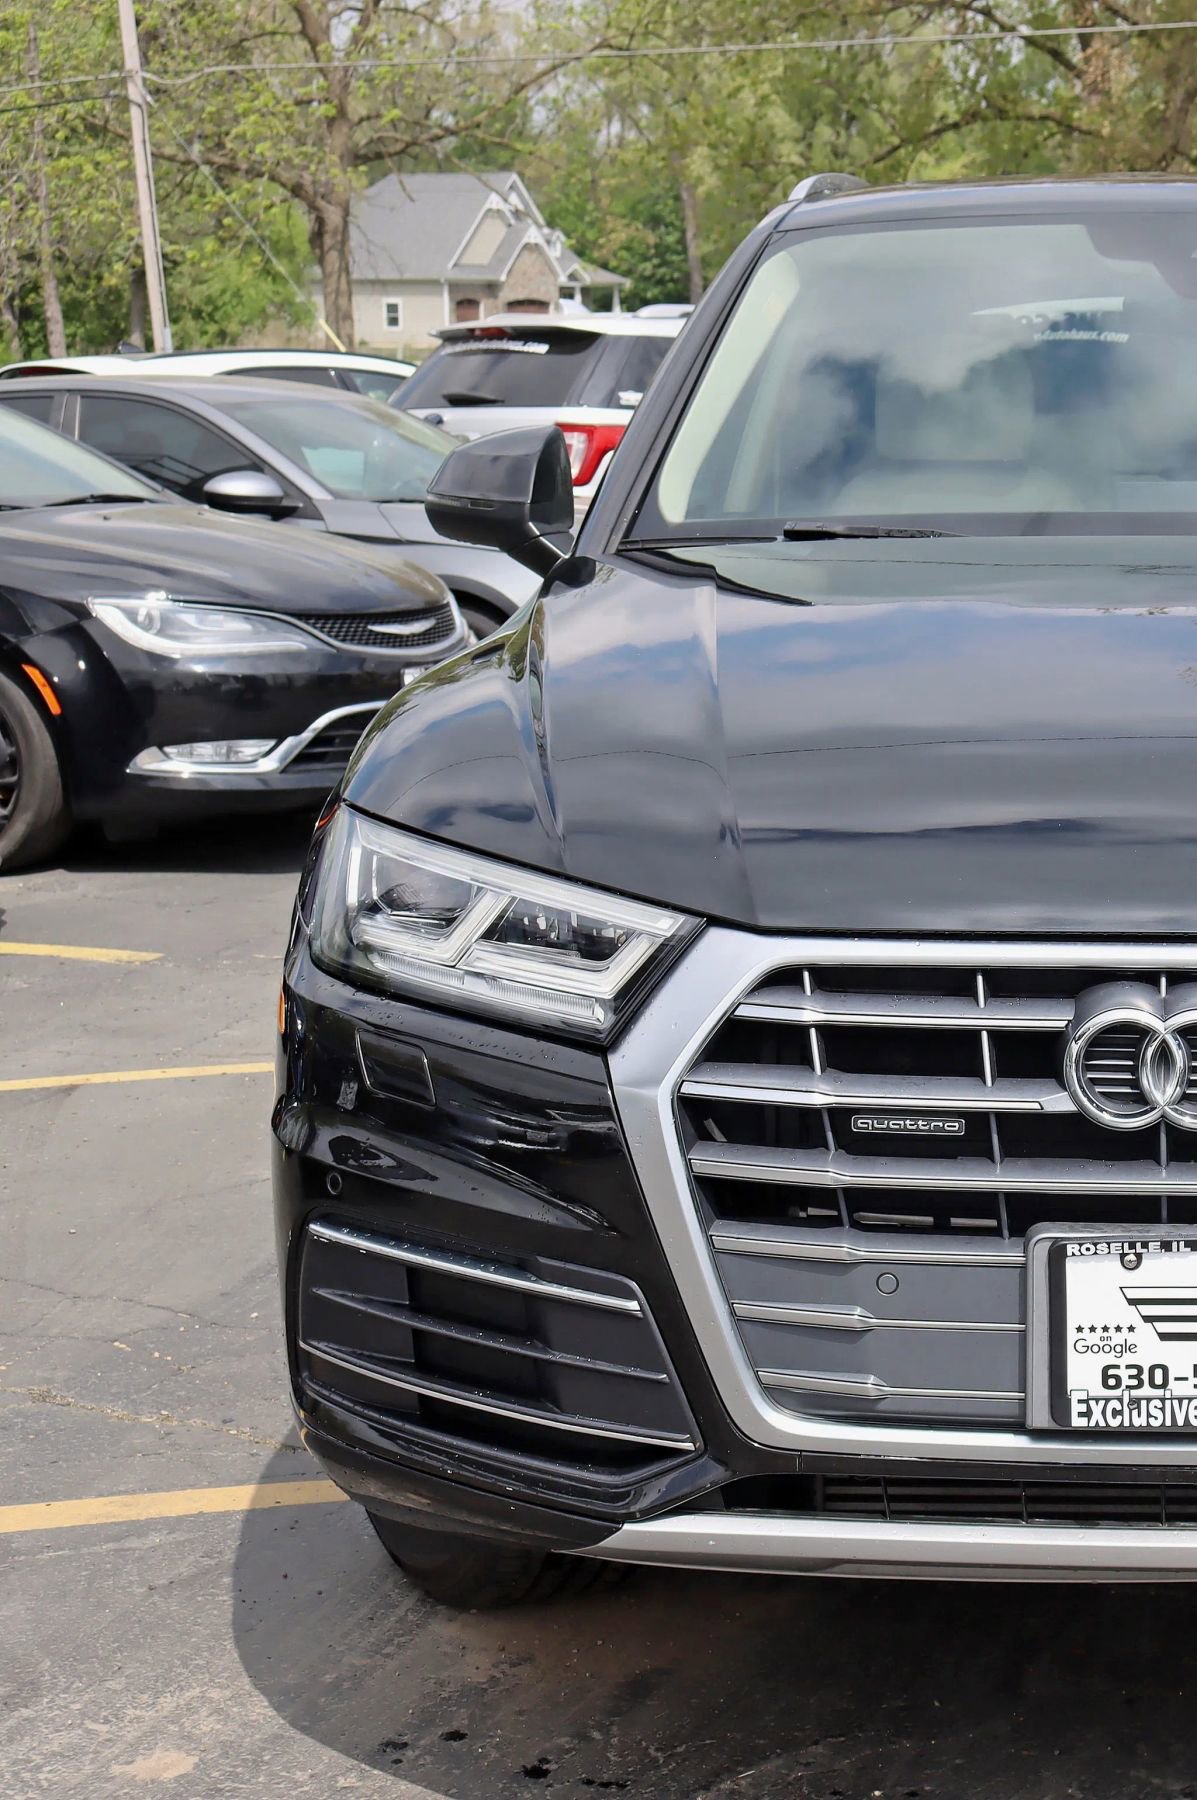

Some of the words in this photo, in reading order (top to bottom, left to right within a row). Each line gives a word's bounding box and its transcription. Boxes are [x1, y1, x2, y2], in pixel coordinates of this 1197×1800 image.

[857, 1119, 960, 1131] quattro
[1066, 1242, 1165, 1256] ROSELLE,
[1171, 1241, 1192, 1252] IL
[1073, 1338, 1138, 1359] Google
